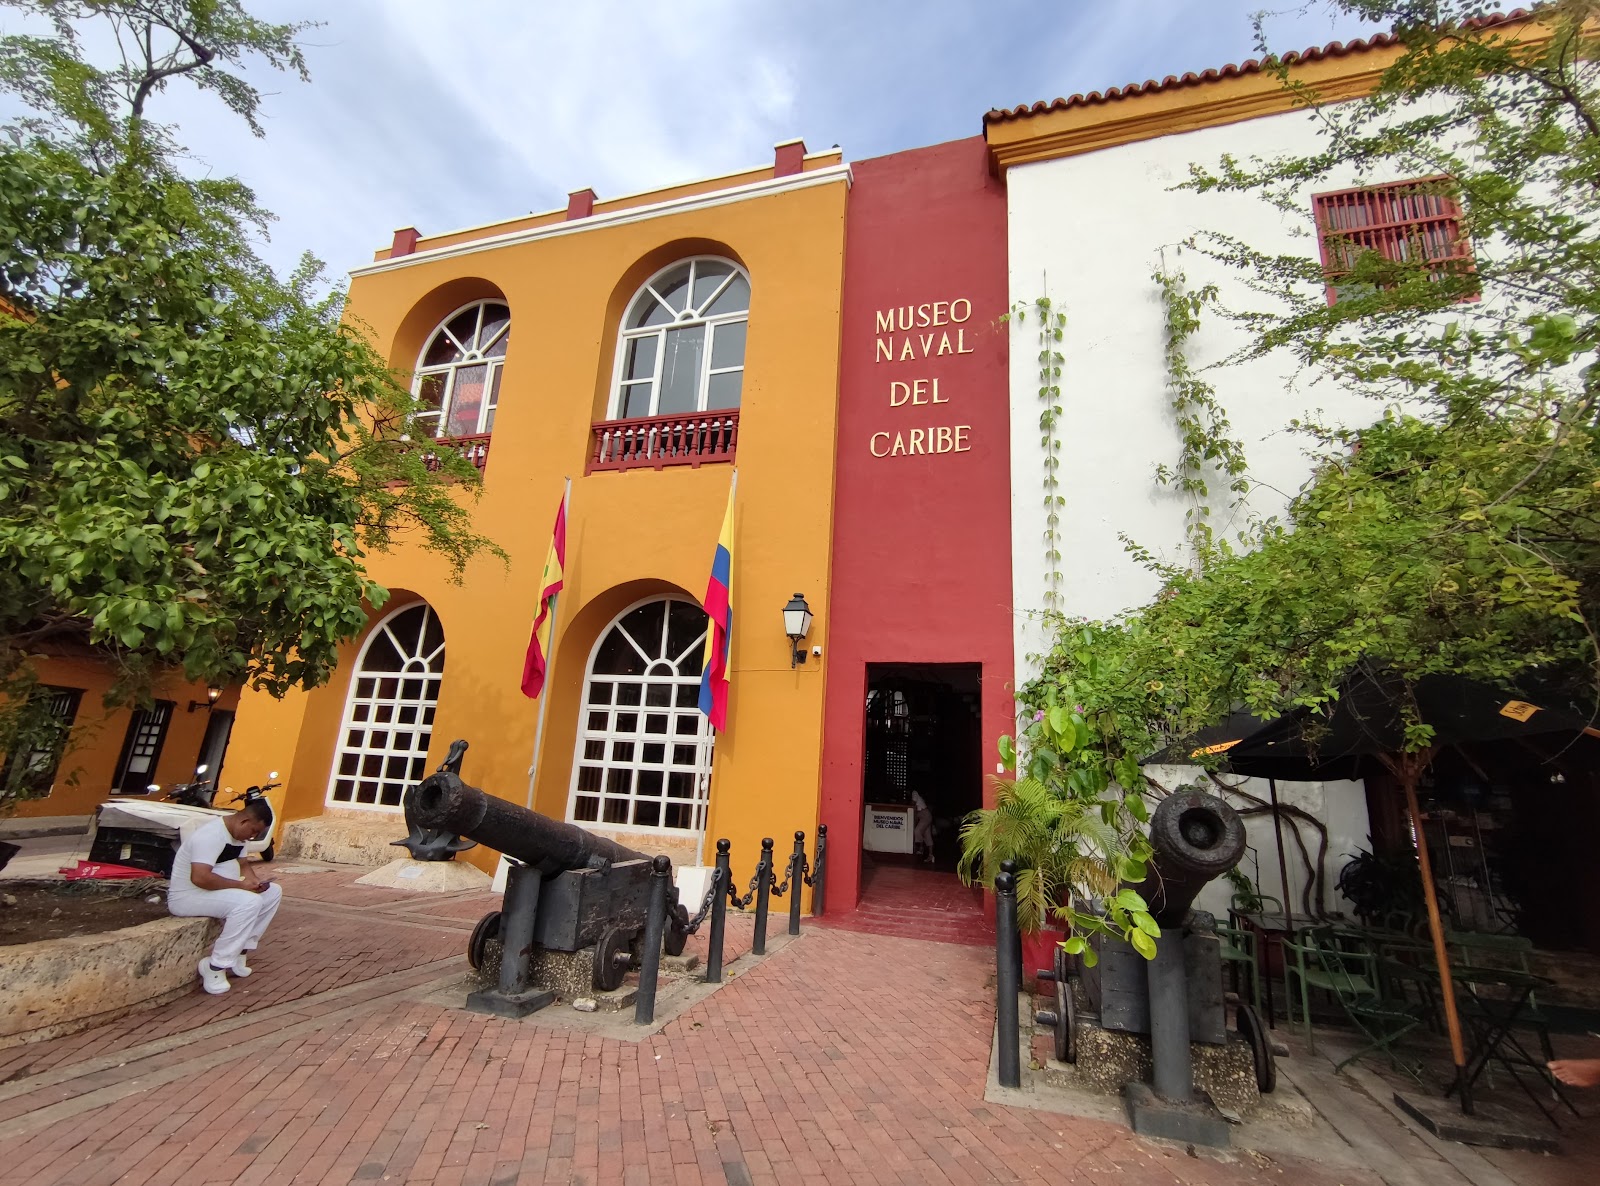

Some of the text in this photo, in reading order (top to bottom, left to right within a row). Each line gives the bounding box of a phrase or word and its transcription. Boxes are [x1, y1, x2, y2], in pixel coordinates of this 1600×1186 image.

[875, 298, 972, 335] MUSEO
[875, 328, 975, 363] NAVAL
[889, 378, 950, 407] DEL
[869, 425, 972, 458] CARIBE
